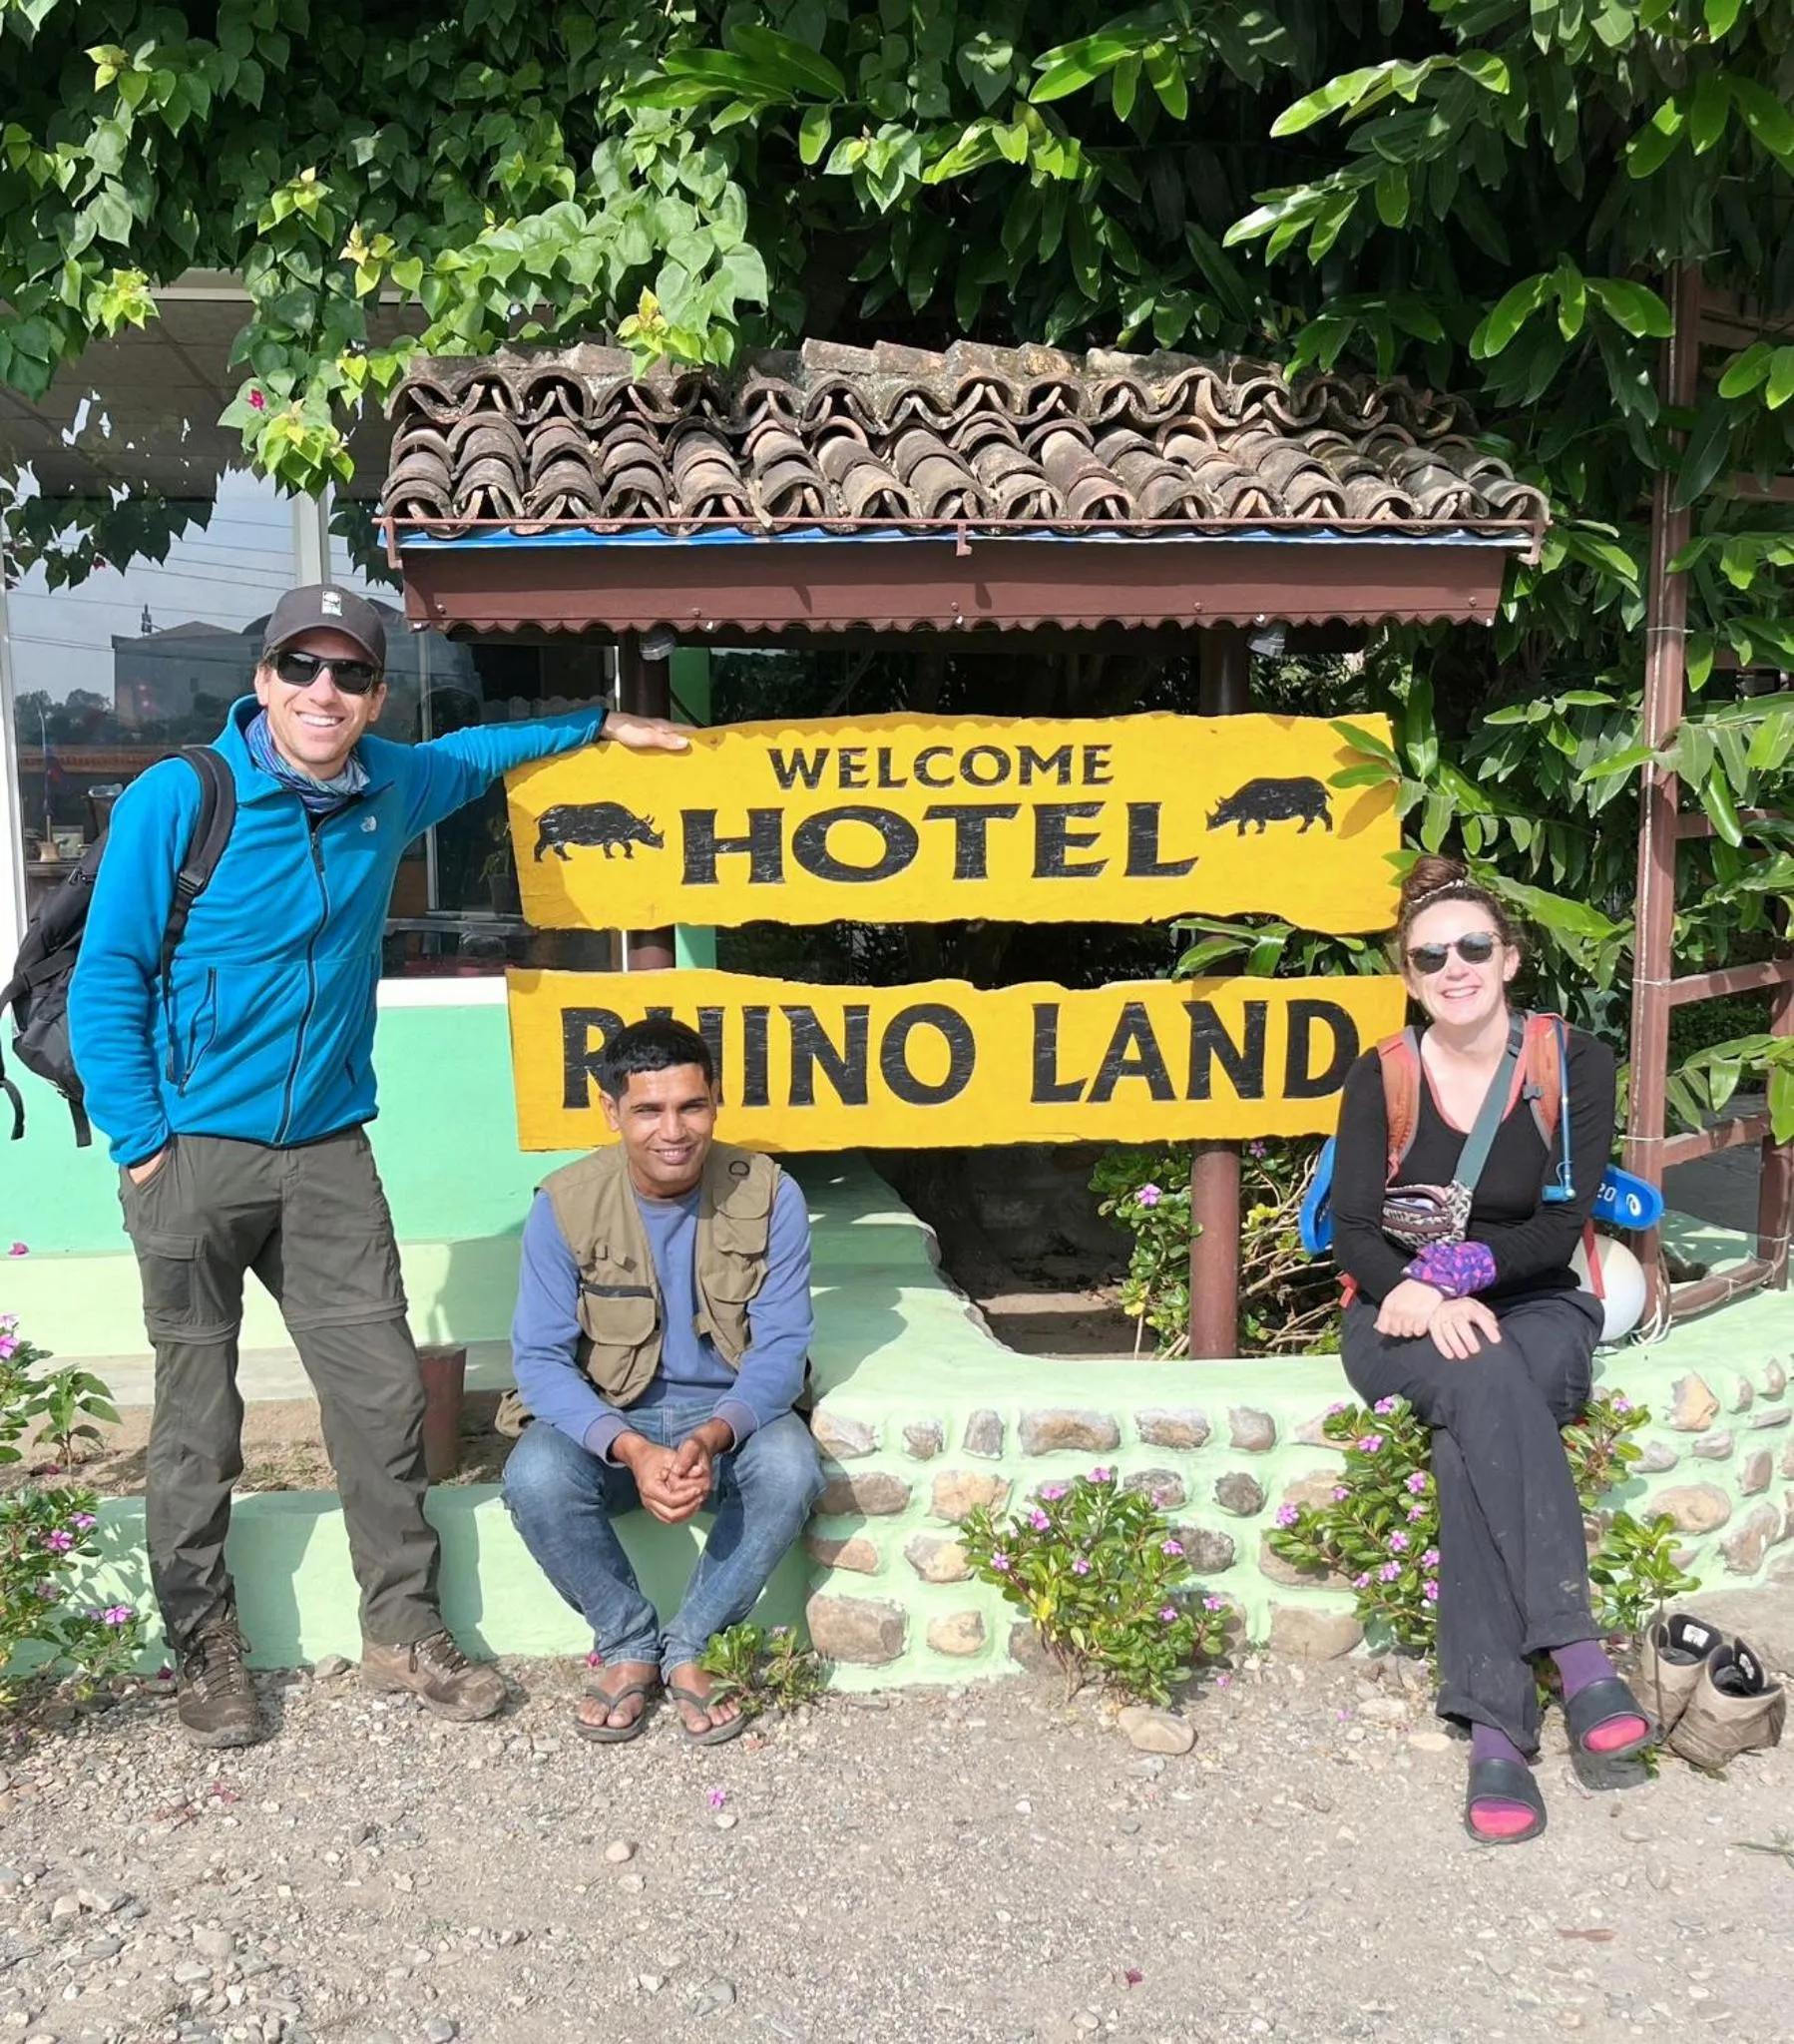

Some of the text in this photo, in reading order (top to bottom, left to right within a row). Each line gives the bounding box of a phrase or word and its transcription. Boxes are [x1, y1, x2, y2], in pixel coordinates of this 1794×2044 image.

[767, 745, 1115, 790] WELCOME
[680, 801, 1199, 886] HOTEL
[1031, 999, 1361, 1105] LAND
